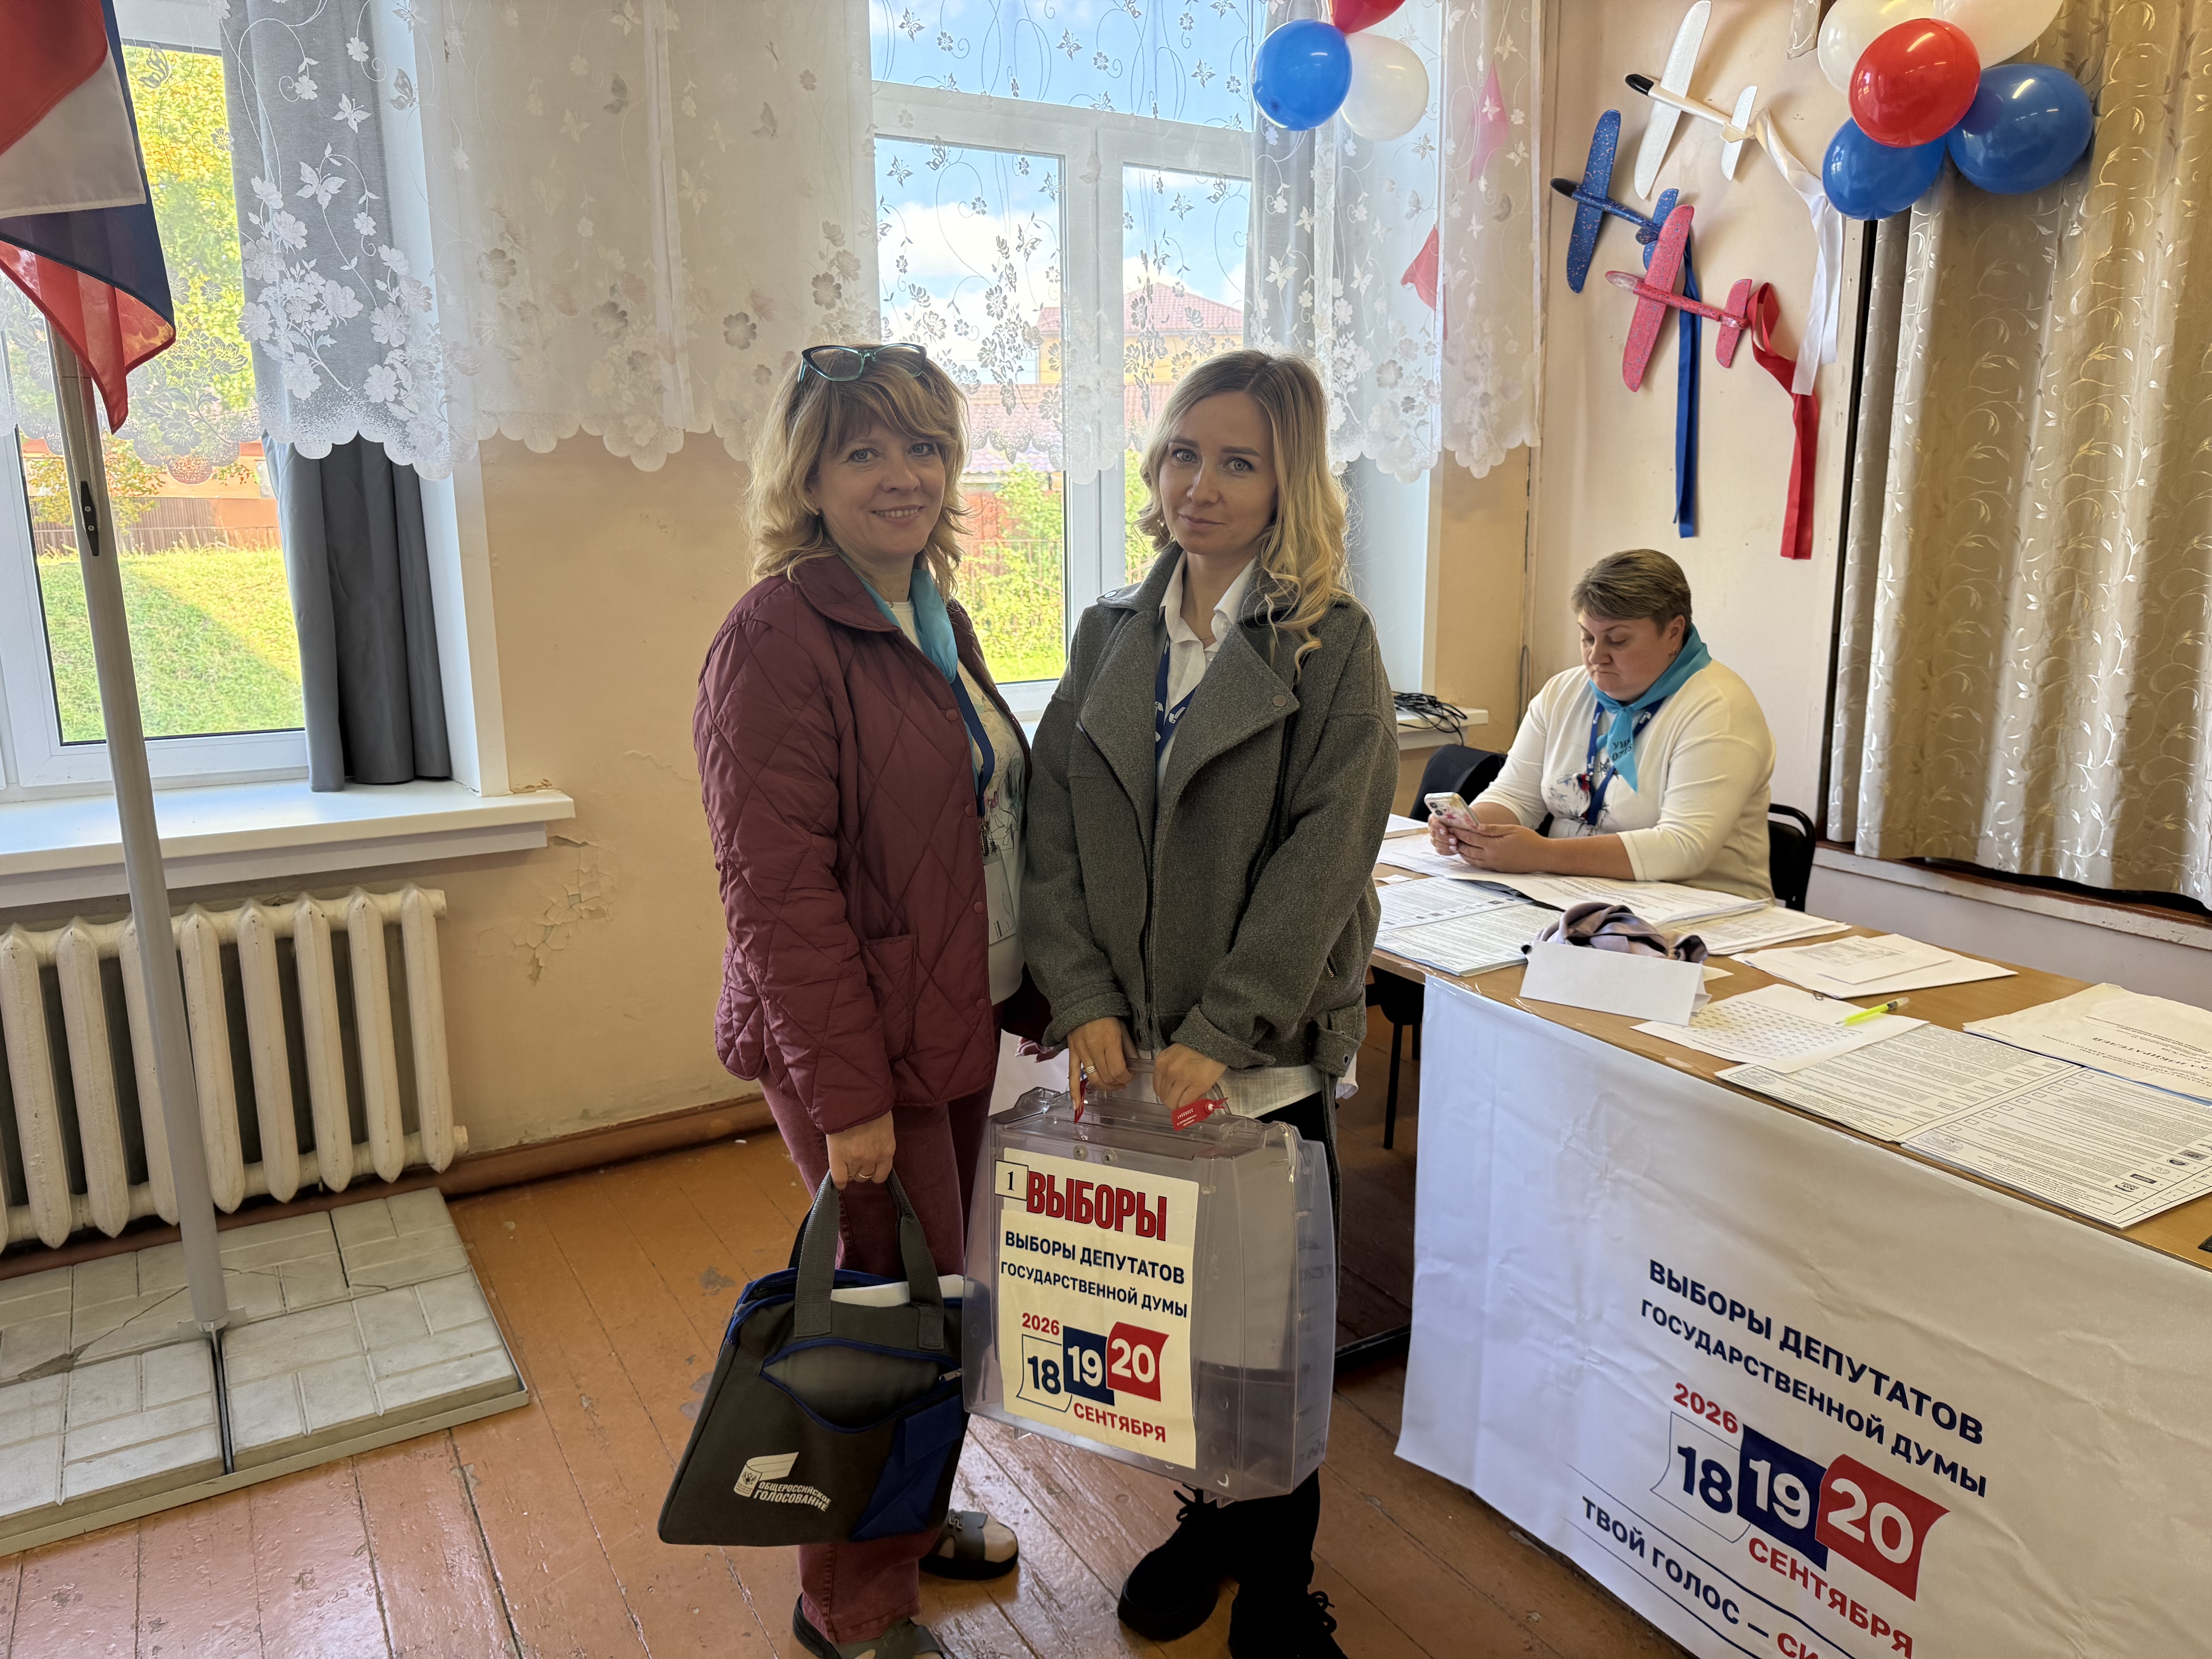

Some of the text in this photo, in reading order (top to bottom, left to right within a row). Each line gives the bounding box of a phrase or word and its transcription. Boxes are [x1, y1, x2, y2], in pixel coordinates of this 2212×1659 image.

[1007, 1171, 1166, 1241] 1 ВЫБОРЫ
[1006, 1231, 1185, 1285] ВЫБОРЫ ДЕПУТАТОВ
[1001, 1262, 1187, 1318] ГОСУДАРСТВЕННОЙ ДУМЫ
[1022, 1312, 1060, 1336] 2026
[1650, 1259, 1983, 1445] ВЫБОРЫ ДЕПУТАТОВ
[1027, 1338, 1156, 1395] 18 19 20
[1074, 1403, 1166, 1443] СЕНТЯБРЯ
[1641, 1298, 1986, 1498] ГОСУДАРСТВЕННОЙ ДУМЫ
[1673, 1382, 1738, 1434] 2026
[754, 1490, 828, 1512] ГОЛОСОВАНИЕ
[759, 1482, 831, 1504] ОБЩЕРОССИЙСКОЕ
[1678, 1446, 1914, 1565] 18 19 20
[1582, 1496, 1644, 1559] ТВОЙ
[1652, 1547, 1740, 1626] ГОЛОС
[1748, 1538, 1913, 1659] СЕНТЯБРЯ
